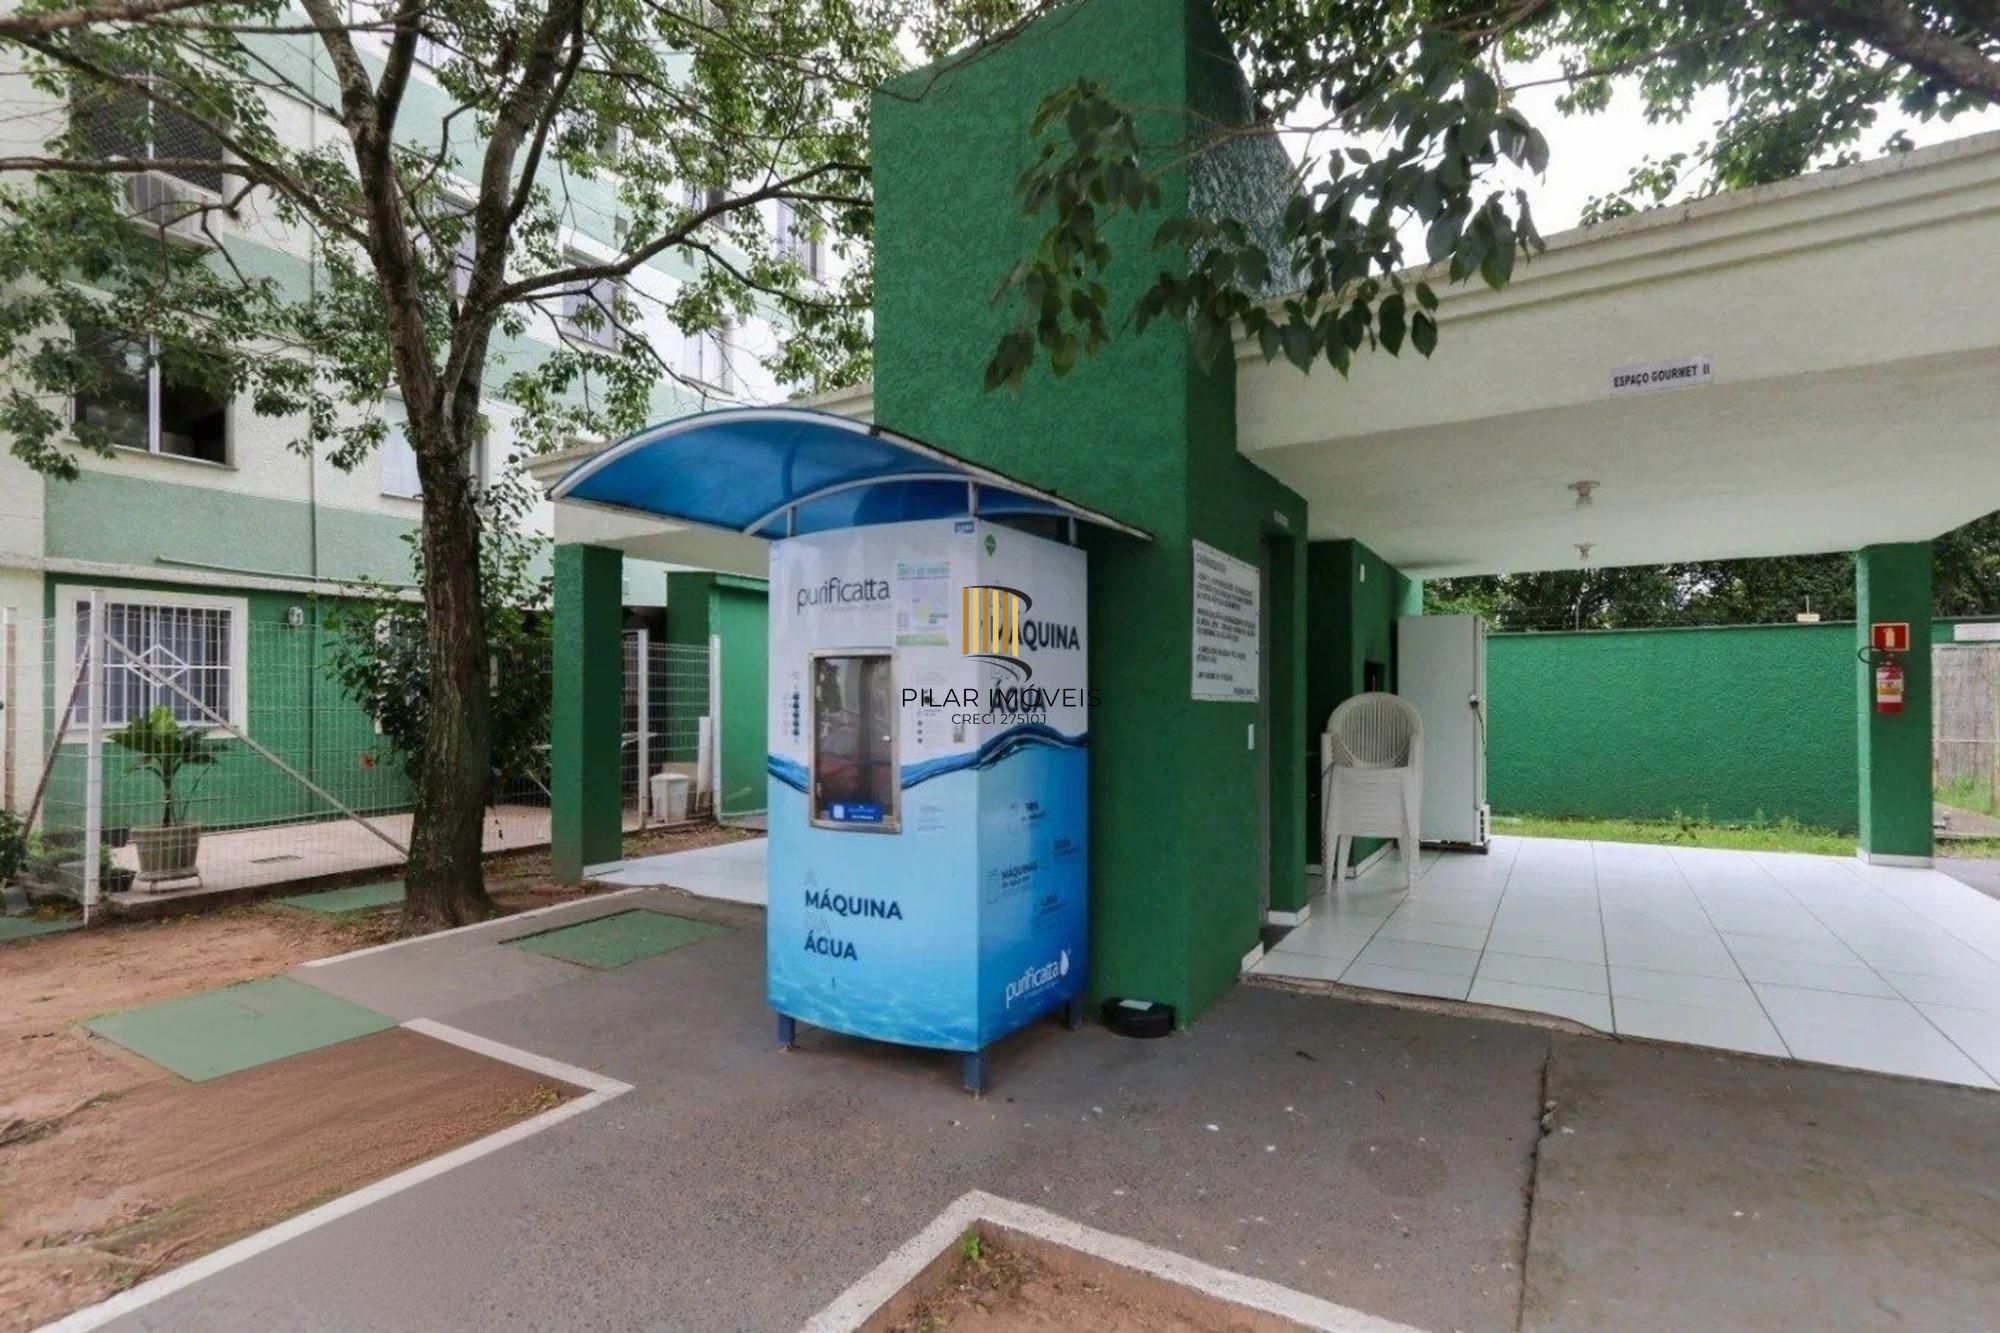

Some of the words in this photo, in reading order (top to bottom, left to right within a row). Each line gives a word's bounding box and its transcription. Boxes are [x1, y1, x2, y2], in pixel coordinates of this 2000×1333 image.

[1613, 372, 1650, 388] ESPAÇO
[1651, 365, 1698, 383] GOURMET
[797, 577, 890, 616] purificatta
[805, 888, 903, 921] MÁQUINA
[803, 930, 858, 962] ÁGUA
